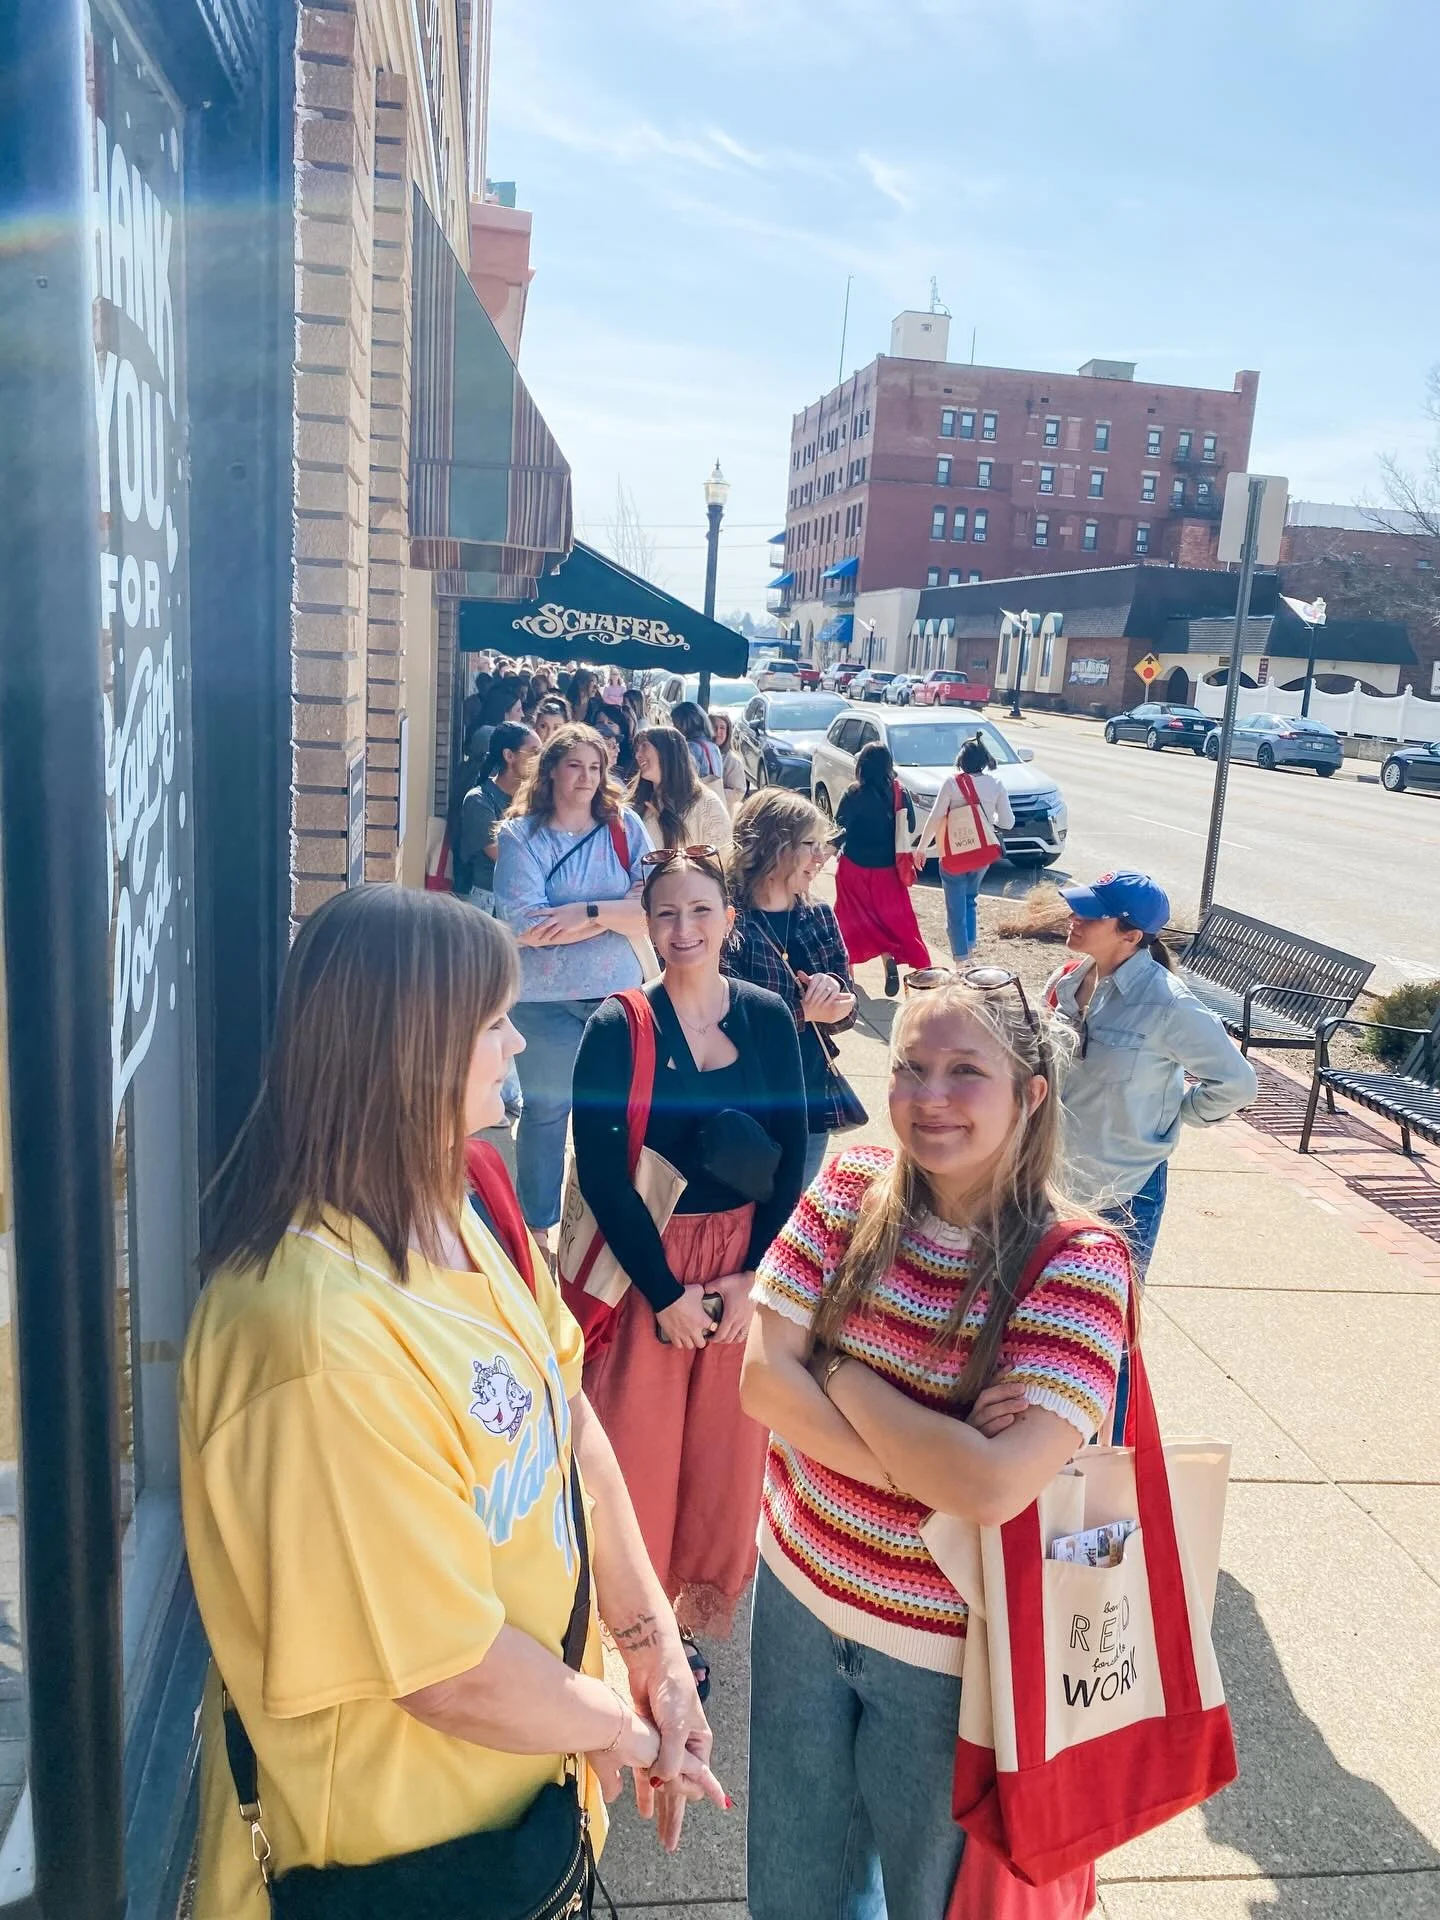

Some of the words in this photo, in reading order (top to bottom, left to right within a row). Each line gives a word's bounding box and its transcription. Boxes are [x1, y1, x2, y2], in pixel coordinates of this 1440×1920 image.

[88, 104, 175, 421] HANK
[94, 342, 165, 530] YOU
[100, 552, 160, 630] FOR
[110, 793, 172, 1147] Local
[1062, 1645, 1137, 1708] WORK
